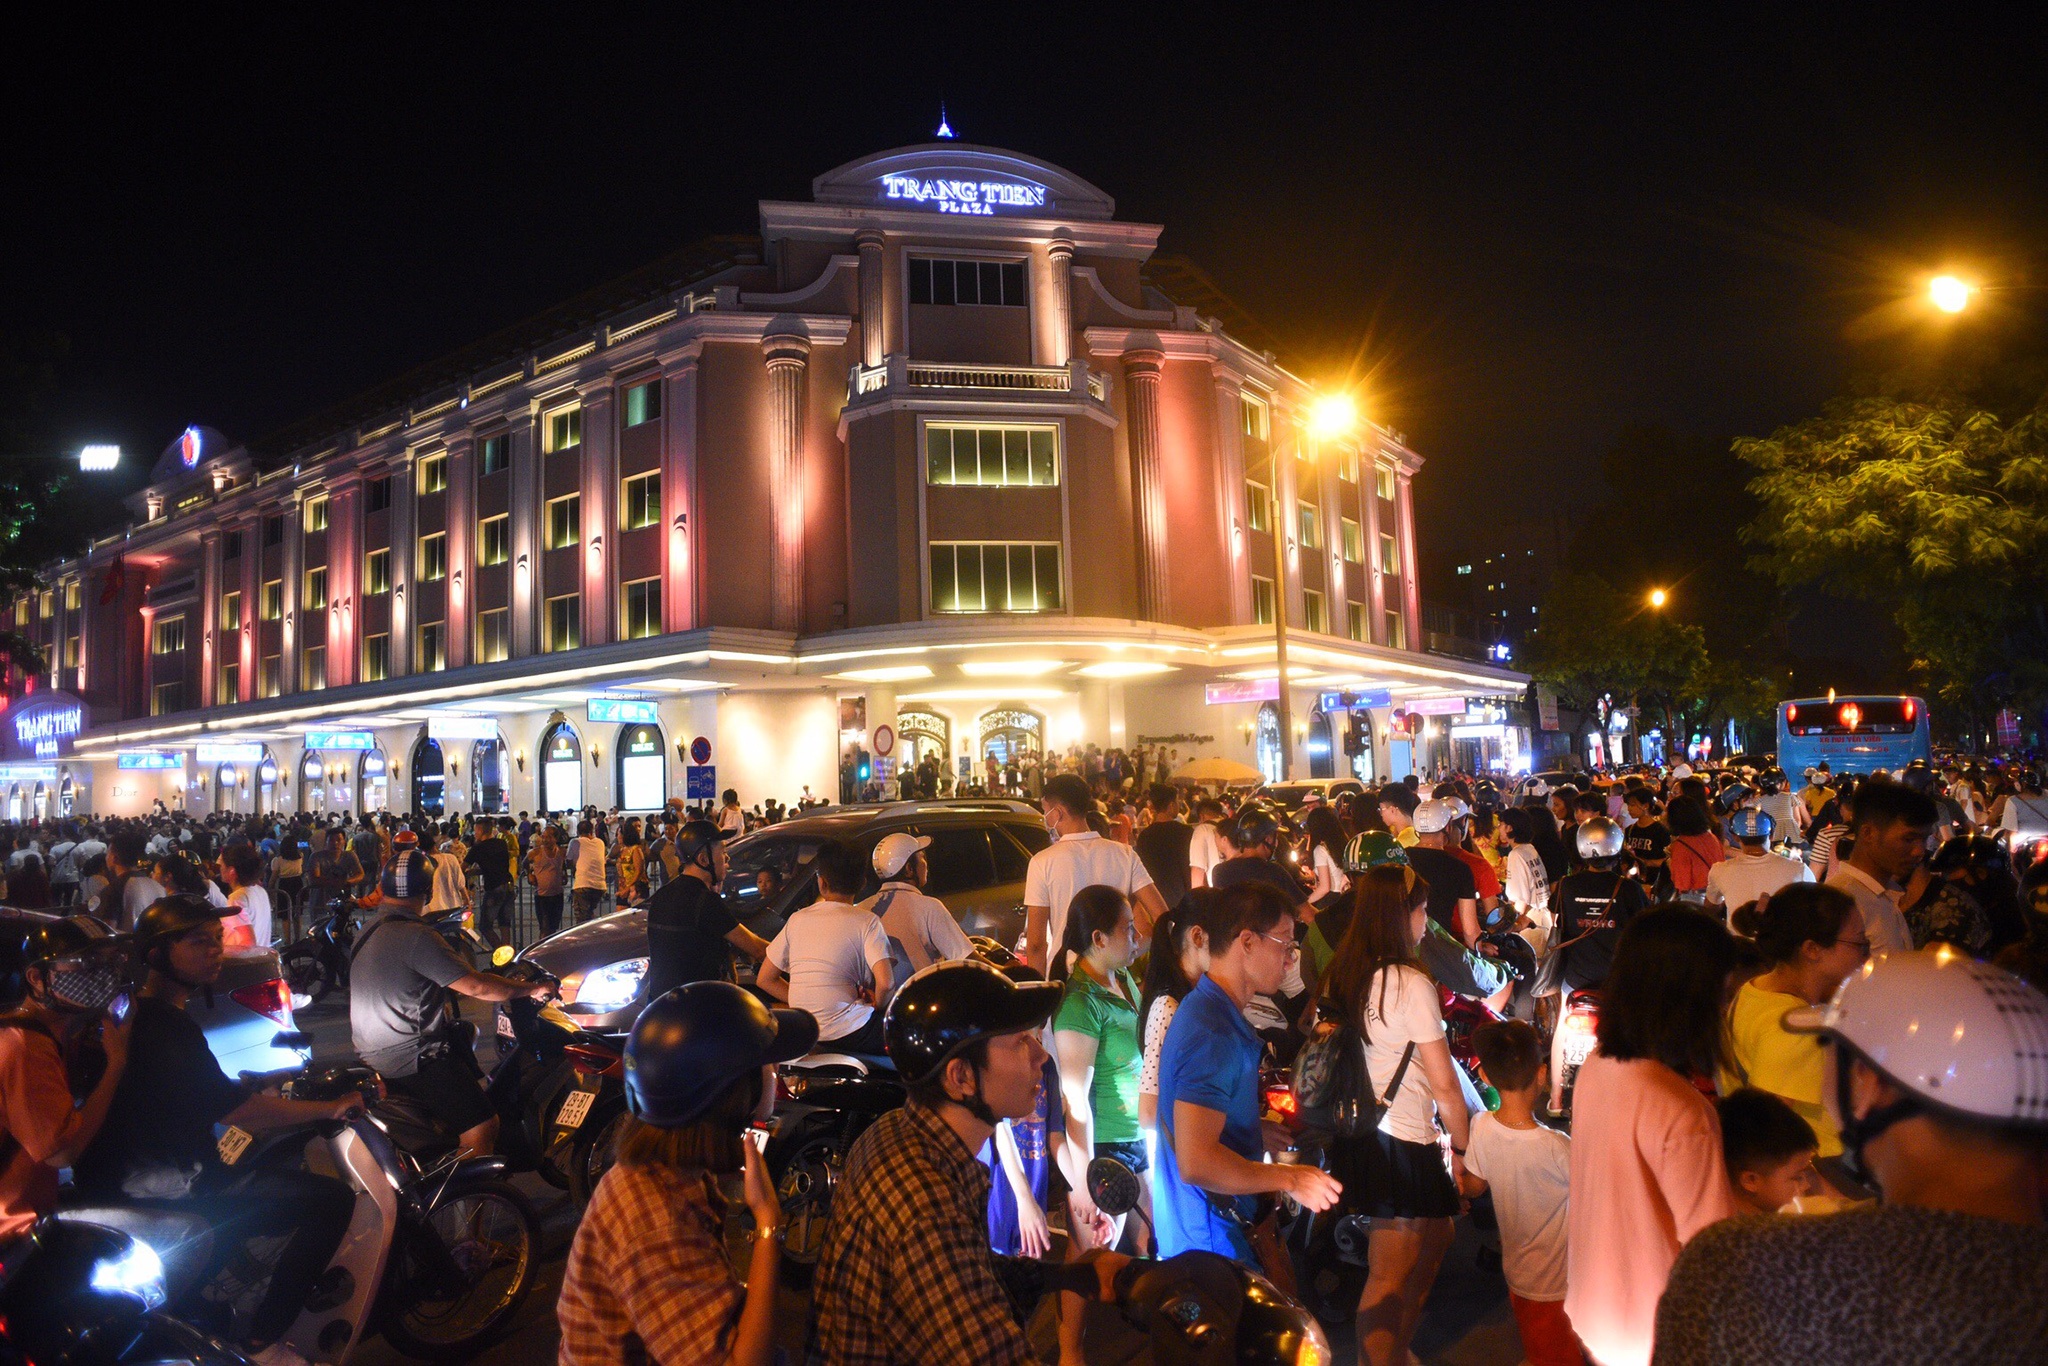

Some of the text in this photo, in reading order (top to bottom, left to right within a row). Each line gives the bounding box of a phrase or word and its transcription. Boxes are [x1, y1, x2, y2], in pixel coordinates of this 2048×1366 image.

[883, 175, 1045, 205] TRANG TIEN
[939, 201, 994, 214] PLAZA
[16, 709, 81, 740] TRANG TIEN
[112, 786, 138, 797] Dior
